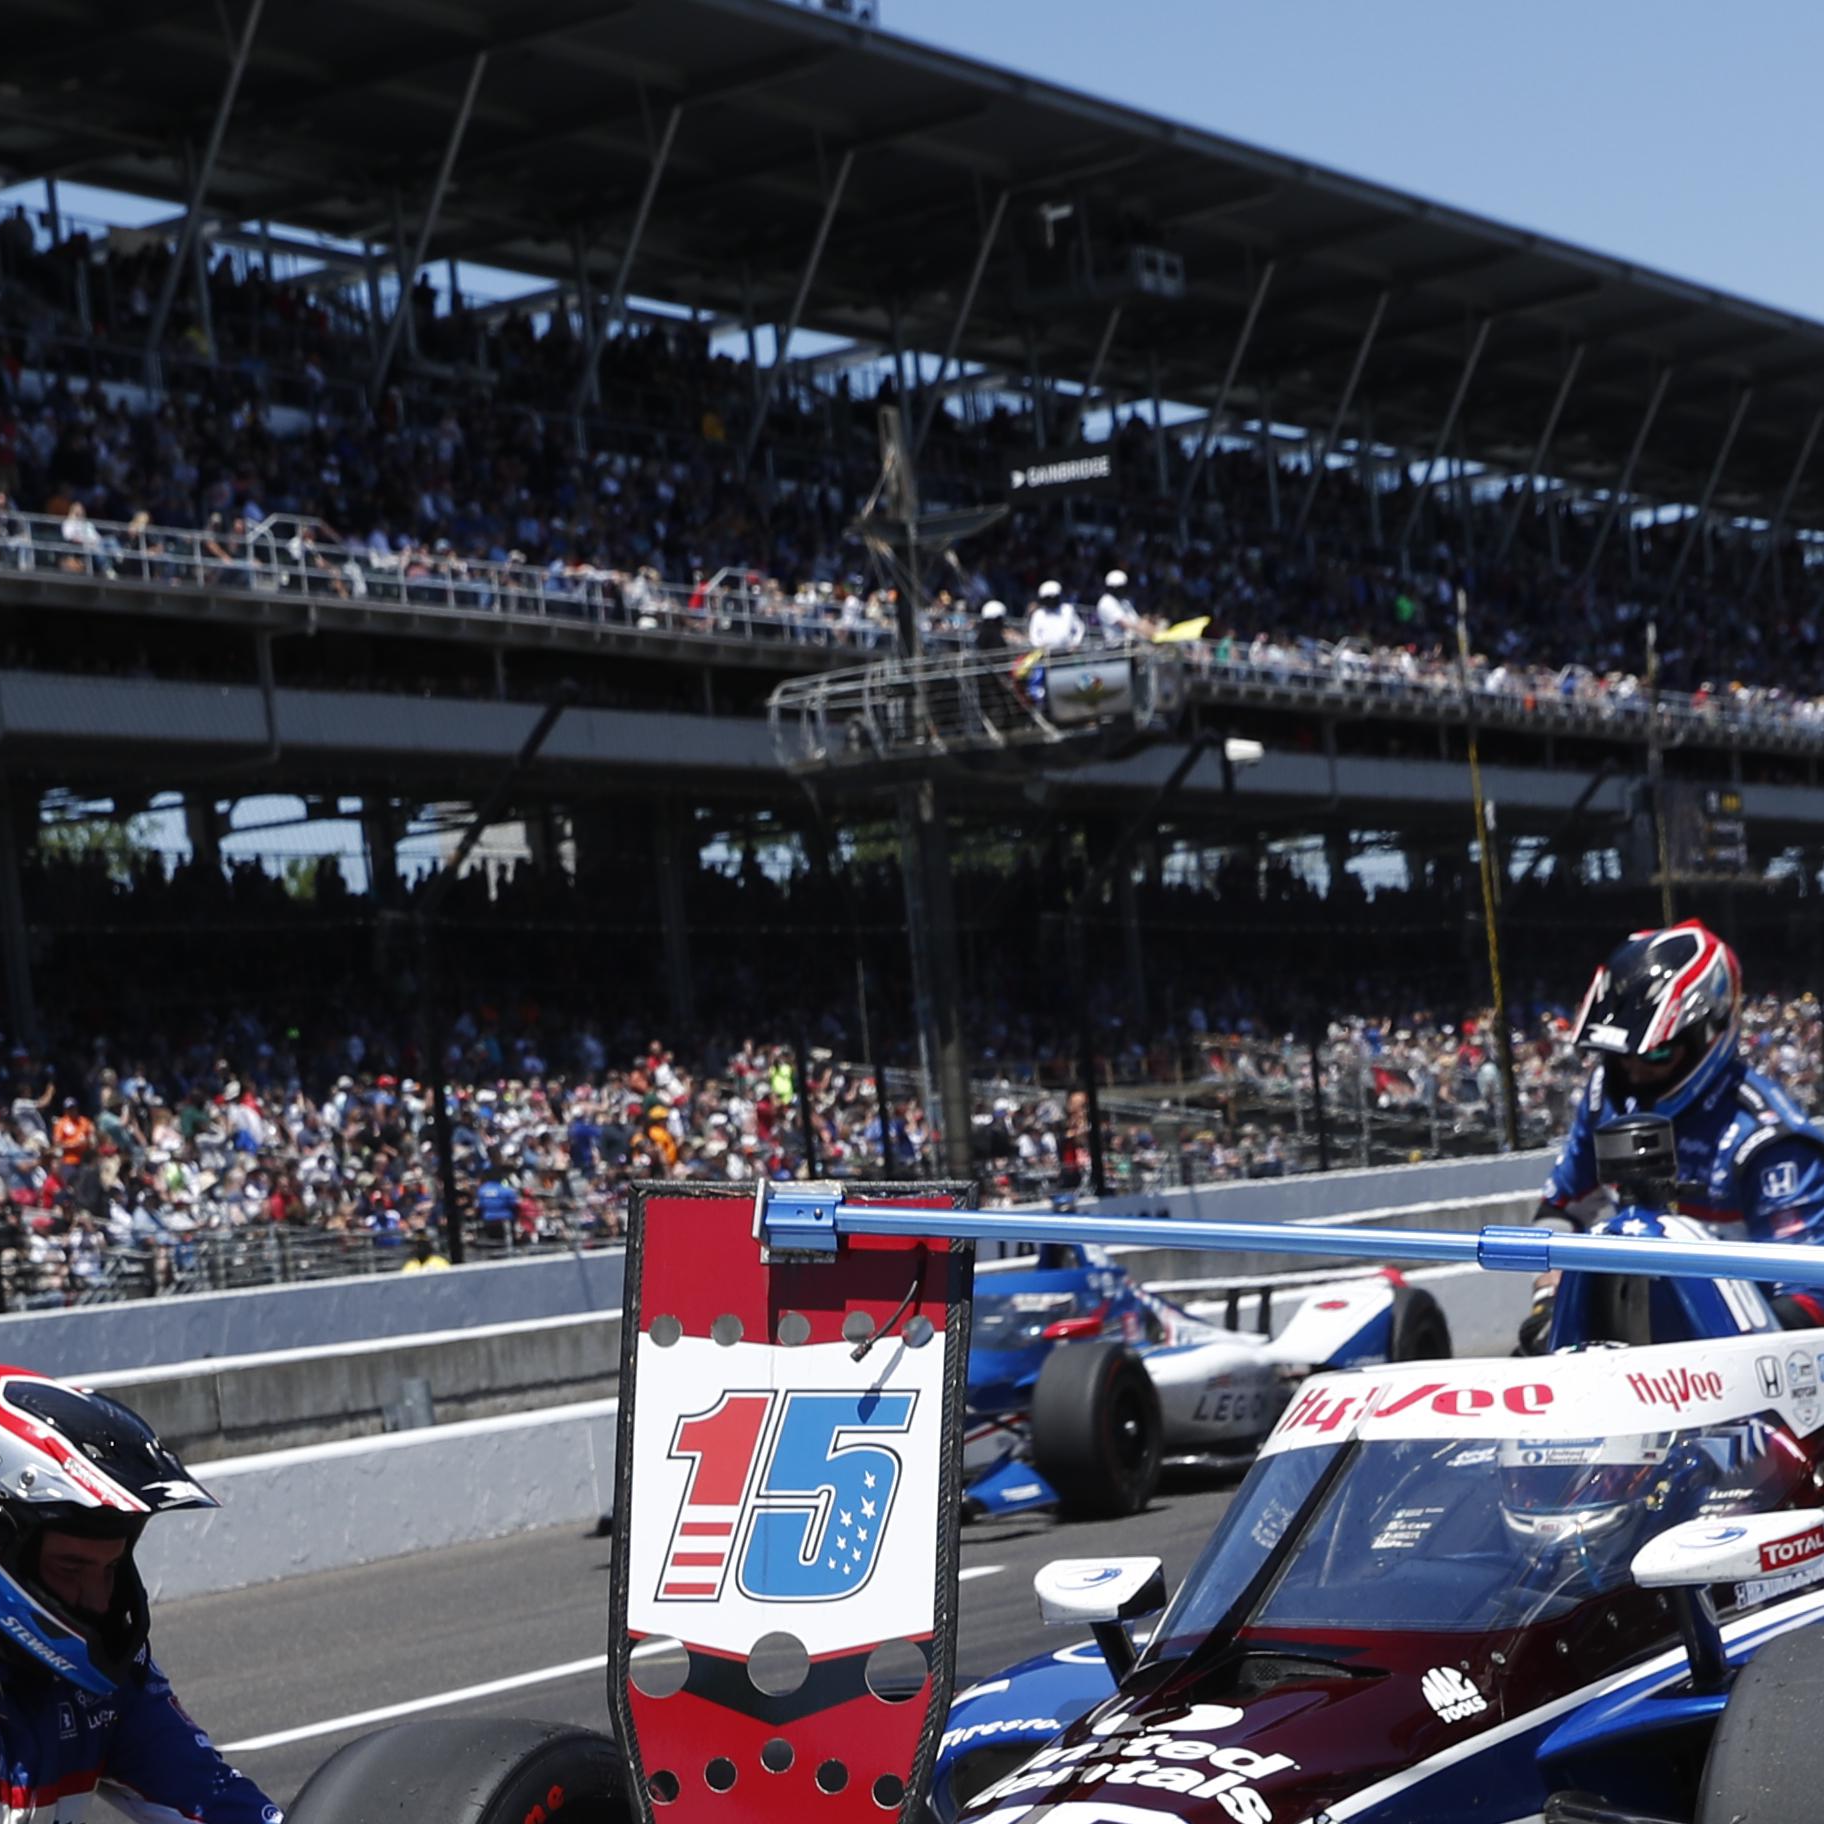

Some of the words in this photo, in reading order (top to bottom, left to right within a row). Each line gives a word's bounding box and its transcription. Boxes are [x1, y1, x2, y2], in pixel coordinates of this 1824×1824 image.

[1624, 1366, 1724, 1414] HyVee
[653, 1388, 921, 1603] 15
[1422, 1665, 1480, 1713] MAC
[1436, 1694, 1488, 1724] TOOLS
